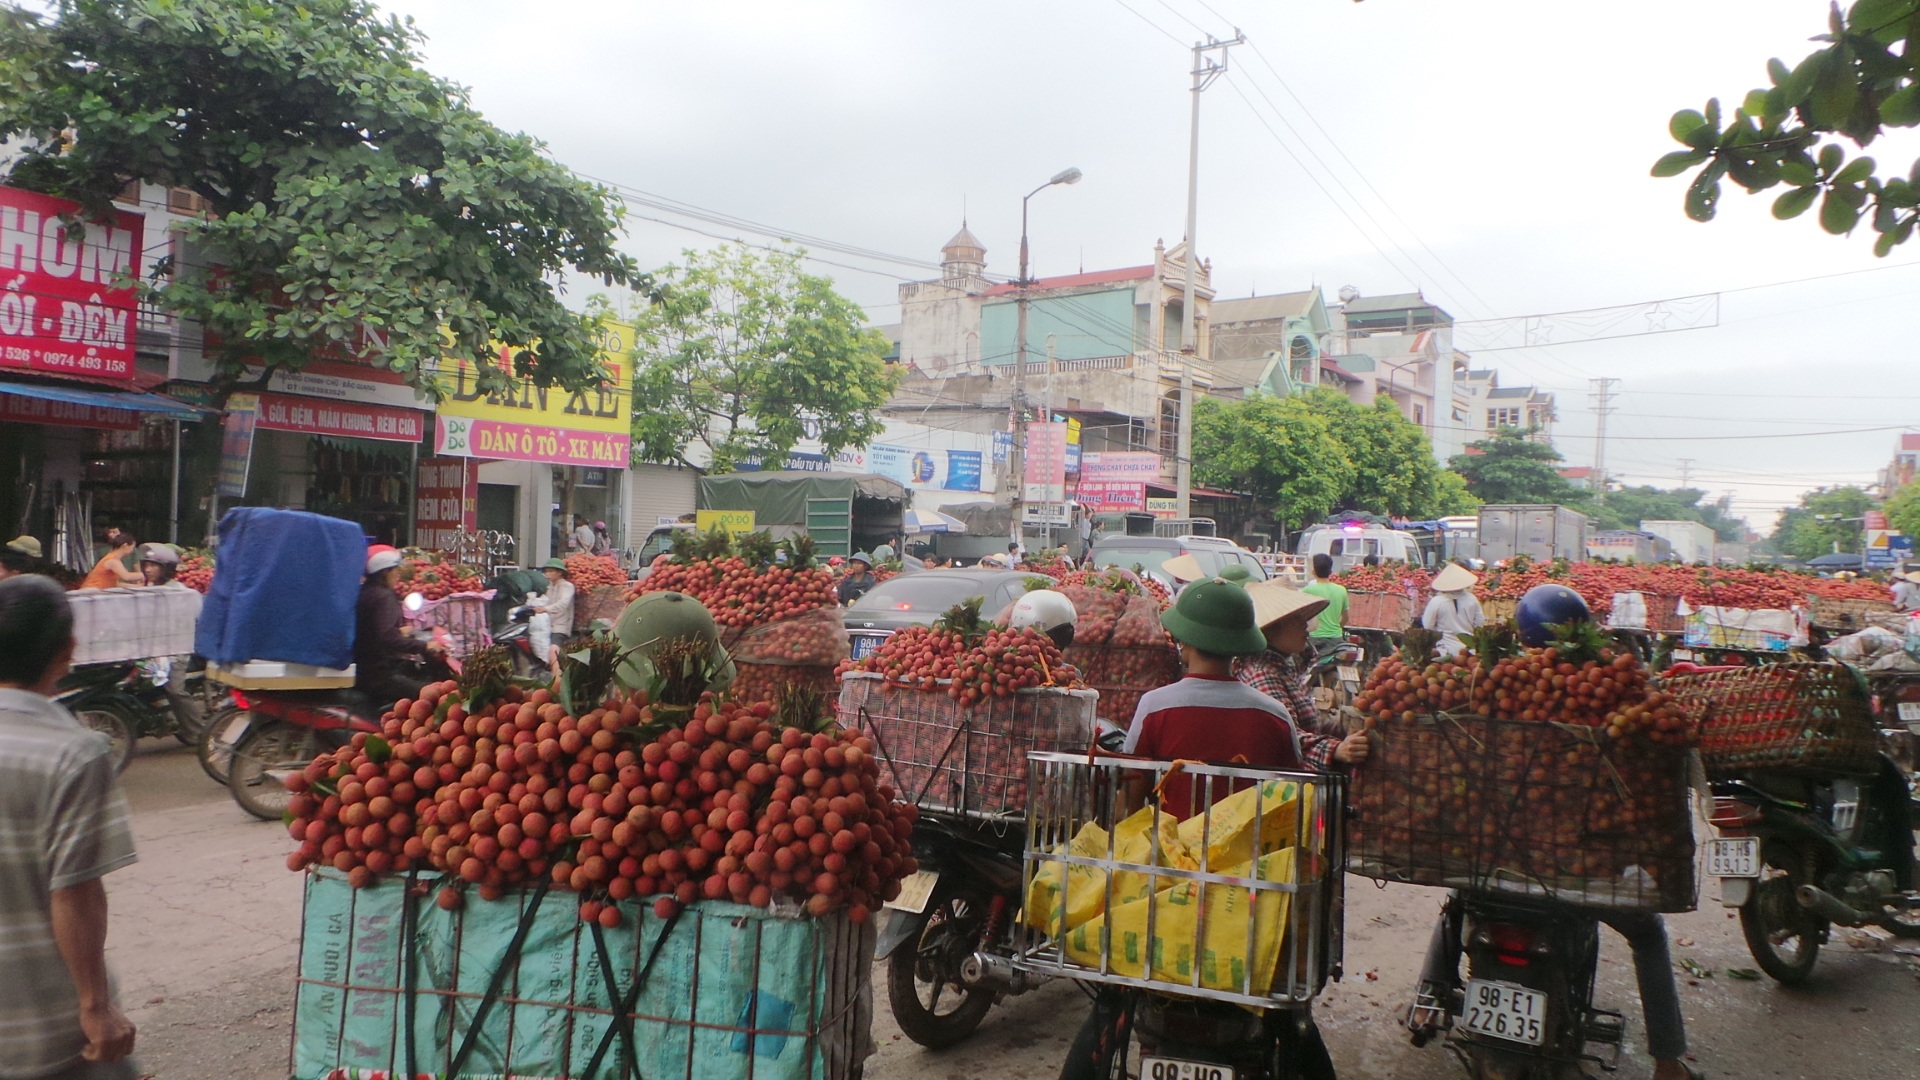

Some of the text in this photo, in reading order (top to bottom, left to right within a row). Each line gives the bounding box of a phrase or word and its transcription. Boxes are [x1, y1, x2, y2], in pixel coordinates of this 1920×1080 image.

[59, 292, 128, 356] ĐỆM
[43, 351, 75, 368] 0974
[77, 356, 101, 370] 493
[105, 358, 126, 372] 158
[480, 425, 624, 462] DÁN Ô TÔ XE MÁY
[441, 490, 460, 521] CỬA
[860, 638, 877, 648] 98A
[1479, 985, 1533, 1016] 98-E1
[1468, 1007, 1540, 1041] 226.35
